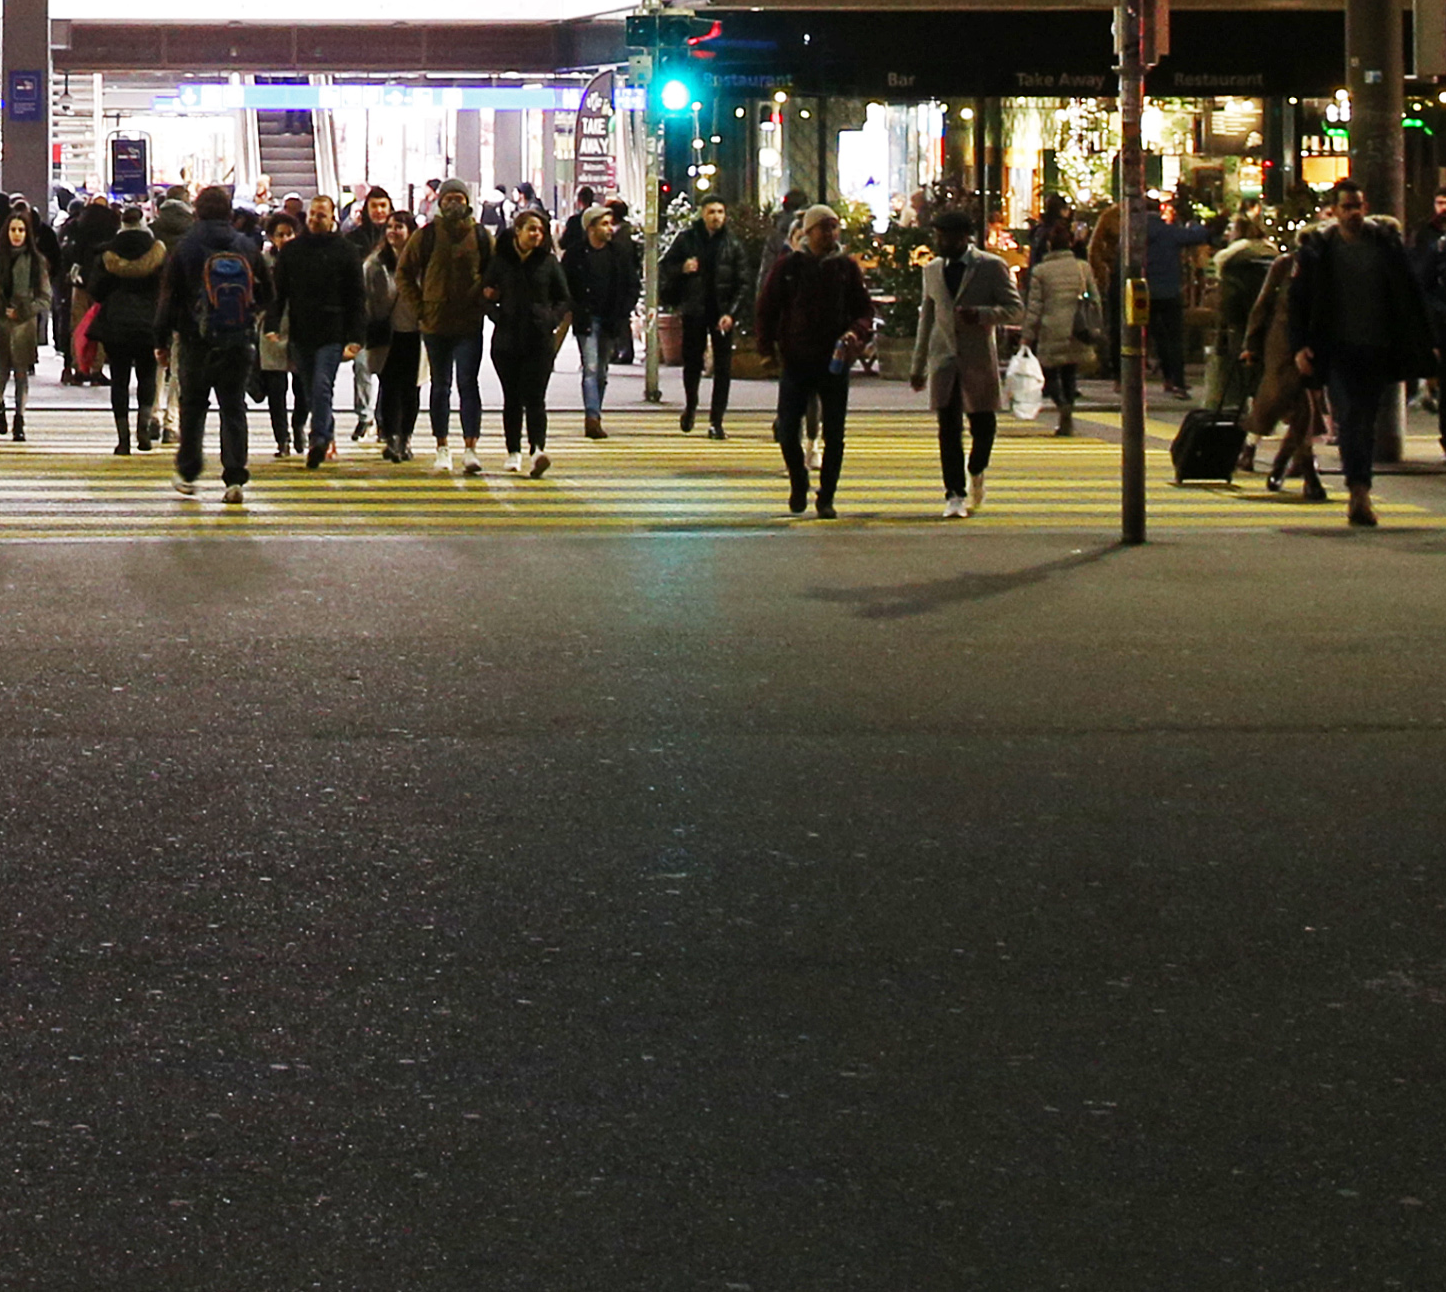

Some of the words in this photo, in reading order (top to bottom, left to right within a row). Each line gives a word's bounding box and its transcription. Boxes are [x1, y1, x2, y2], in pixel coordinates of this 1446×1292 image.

[887, 73, 915, 87] Bar
[1016, 72, 1054, 87] Take
[1059, 72, 1104, 90] Away
[1174, 72, 1264, 87] Restaurant
[579, 137, 609, 154] AWAY
